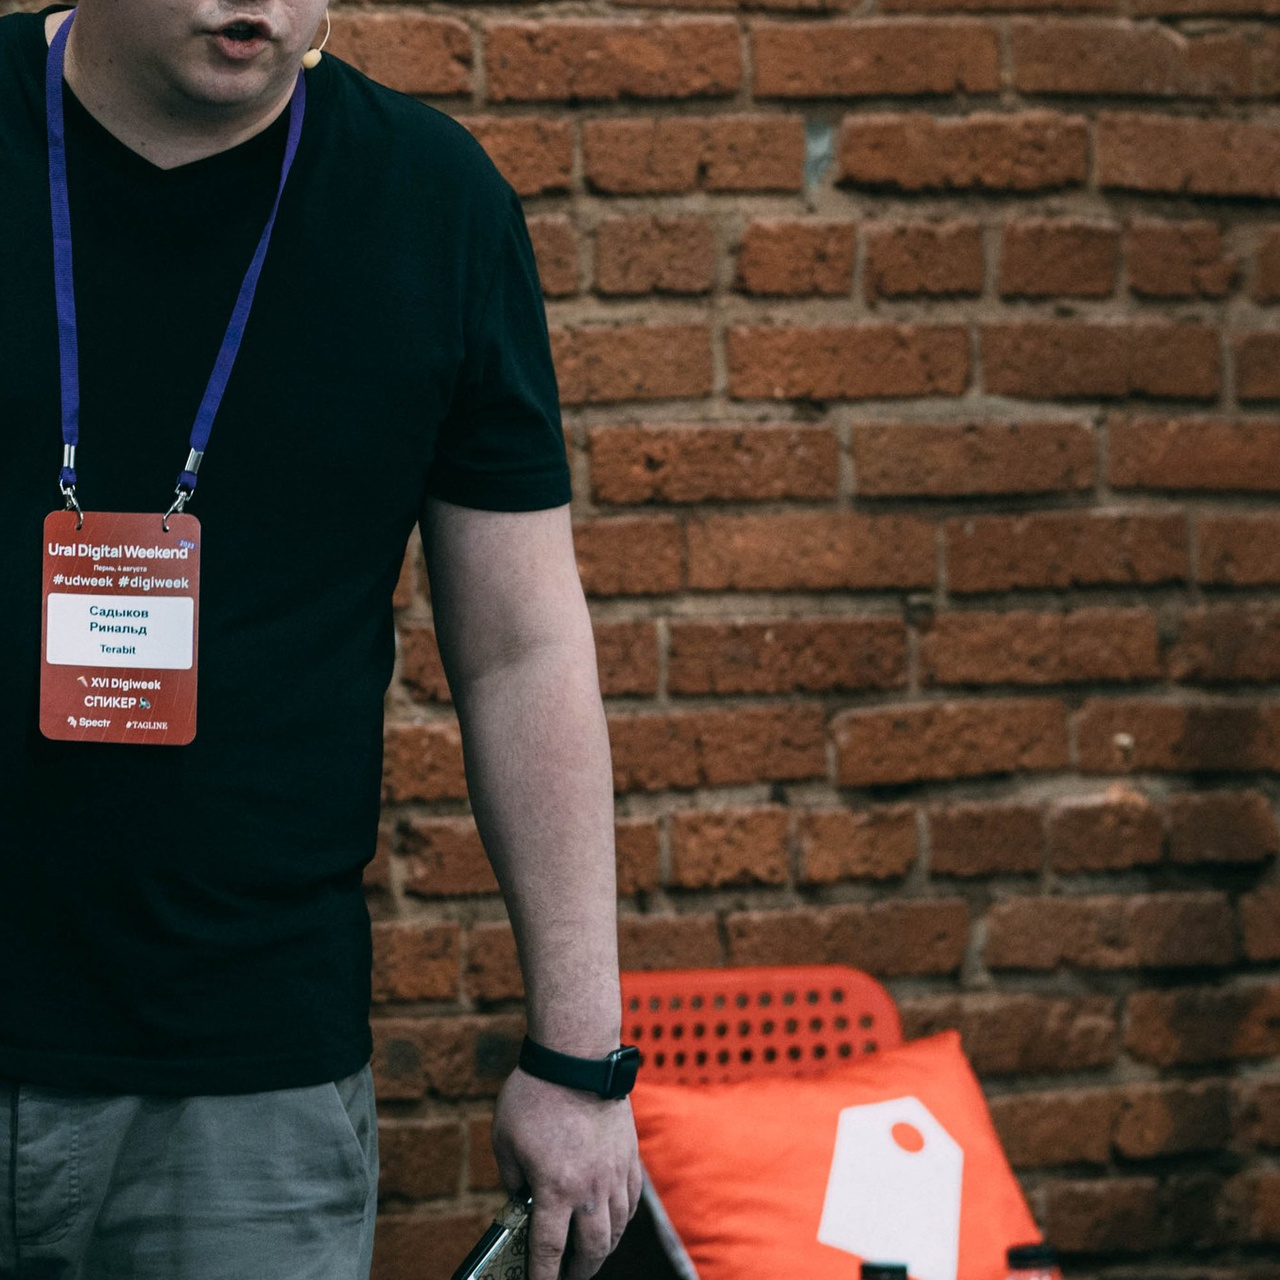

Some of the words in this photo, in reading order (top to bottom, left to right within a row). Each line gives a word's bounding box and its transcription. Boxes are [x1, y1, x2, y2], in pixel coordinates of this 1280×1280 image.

[48, 542, 76, 557] Ural
[77, 543, 123, 561] Digital
[123, 545, 189, 560] Weekend
[53, 573, 114, 588] #udweek
[118, 575, 189, 592] #digiweek
[89, 605, 149, 619] Садыков
[89, 621, 148, 636] Ринальд
[100, 644, 137, 655] Terabit
[91, 677, 110, 688] XVI
[111, 678, 161, 692] Digiweek
[84, 695, 137, 709] СПИКЕР
[79, 717, 111, 729] Spectr
